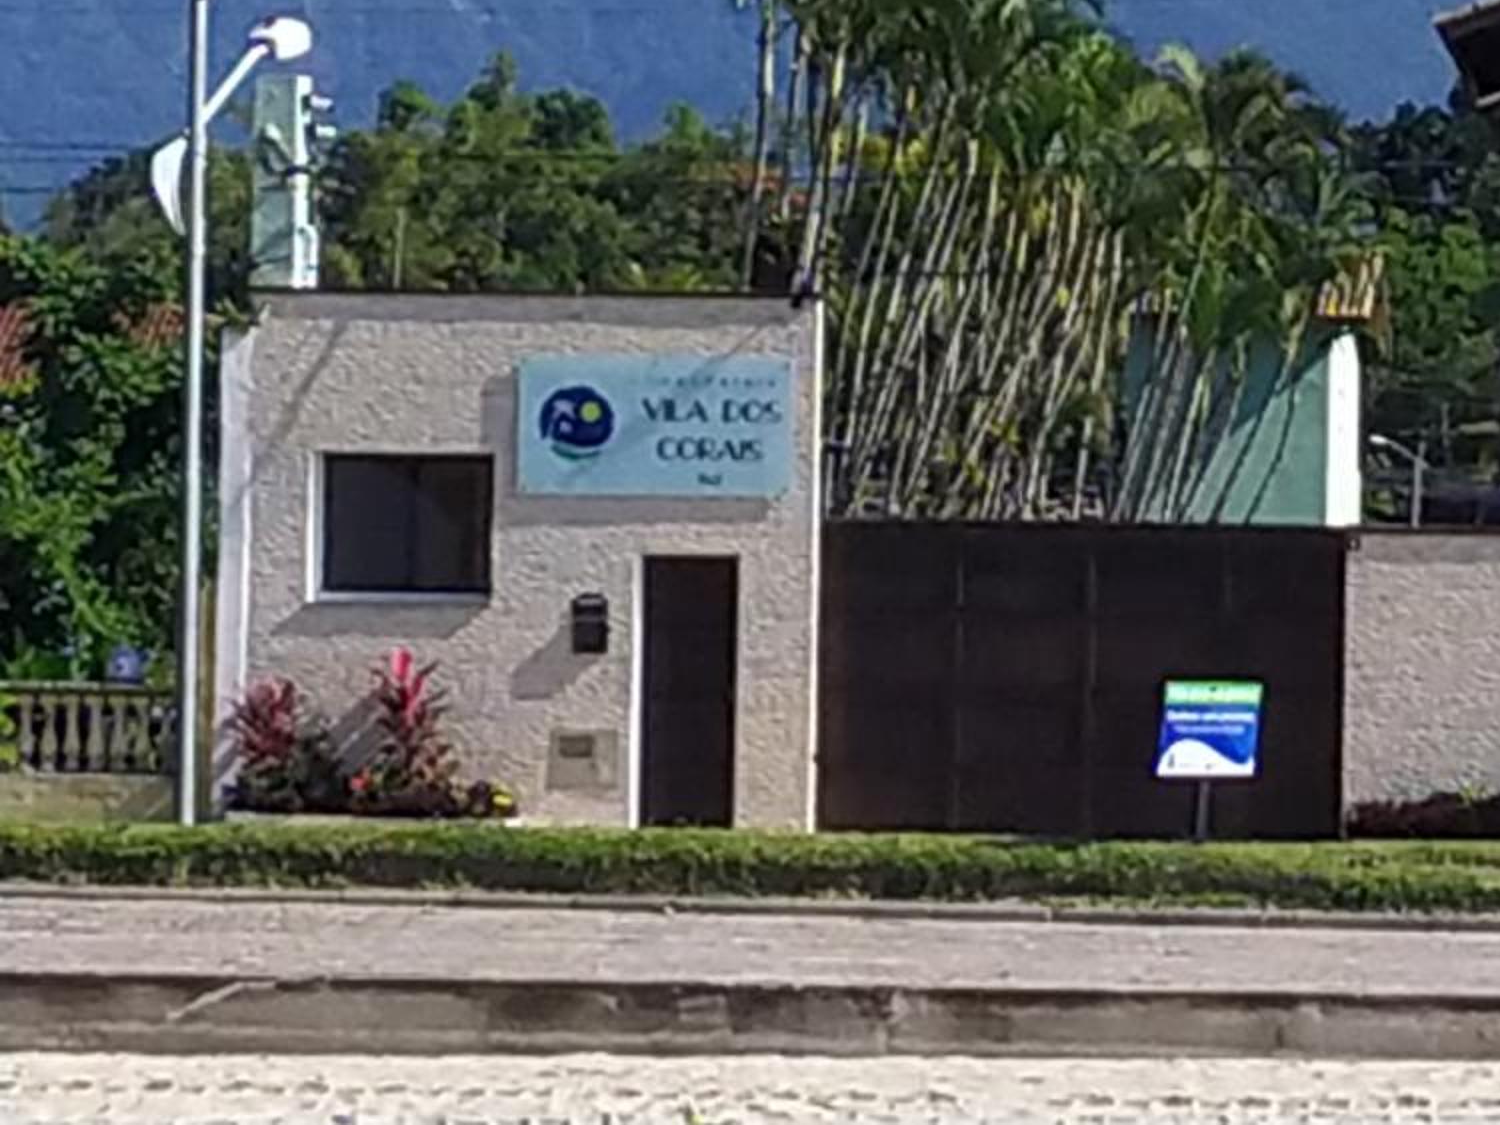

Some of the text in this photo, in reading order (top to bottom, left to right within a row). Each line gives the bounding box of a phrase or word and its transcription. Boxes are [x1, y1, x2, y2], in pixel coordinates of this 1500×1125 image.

[641, 397, 783, 424] VILA DOS
[655, 436, 765, 462] CORAIS
